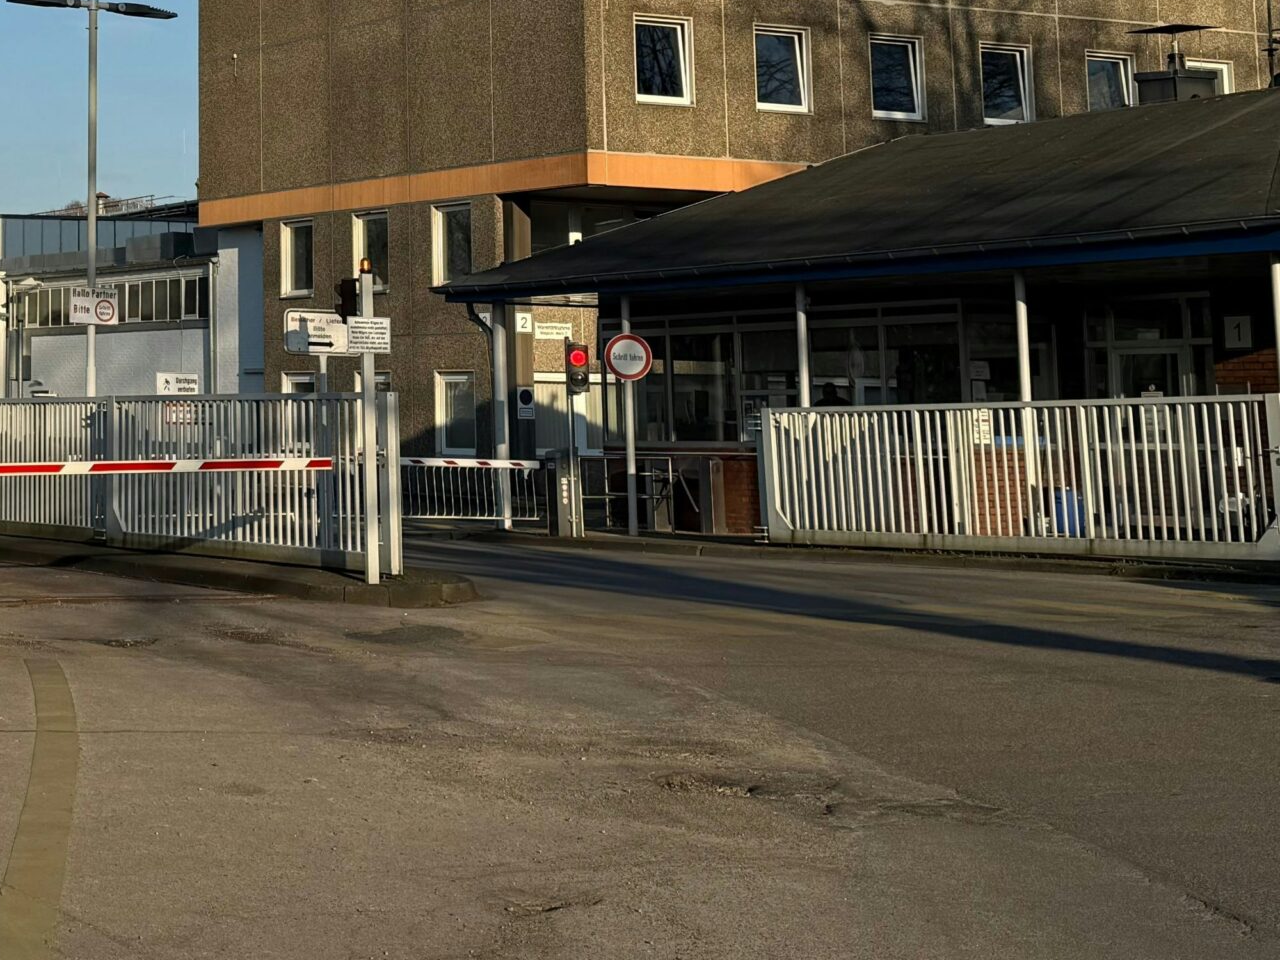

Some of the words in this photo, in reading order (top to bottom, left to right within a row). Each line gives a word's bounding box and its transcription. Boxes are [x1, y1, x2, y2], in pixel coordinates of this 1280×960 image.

[72, 287, 90, 298] Hallo
[91, 288, 117, 299] Partner
[73, 304, 90, 314] Bitte
[520, 316, 528, 329] 2
[1232, 321, 1242, 342] 1
